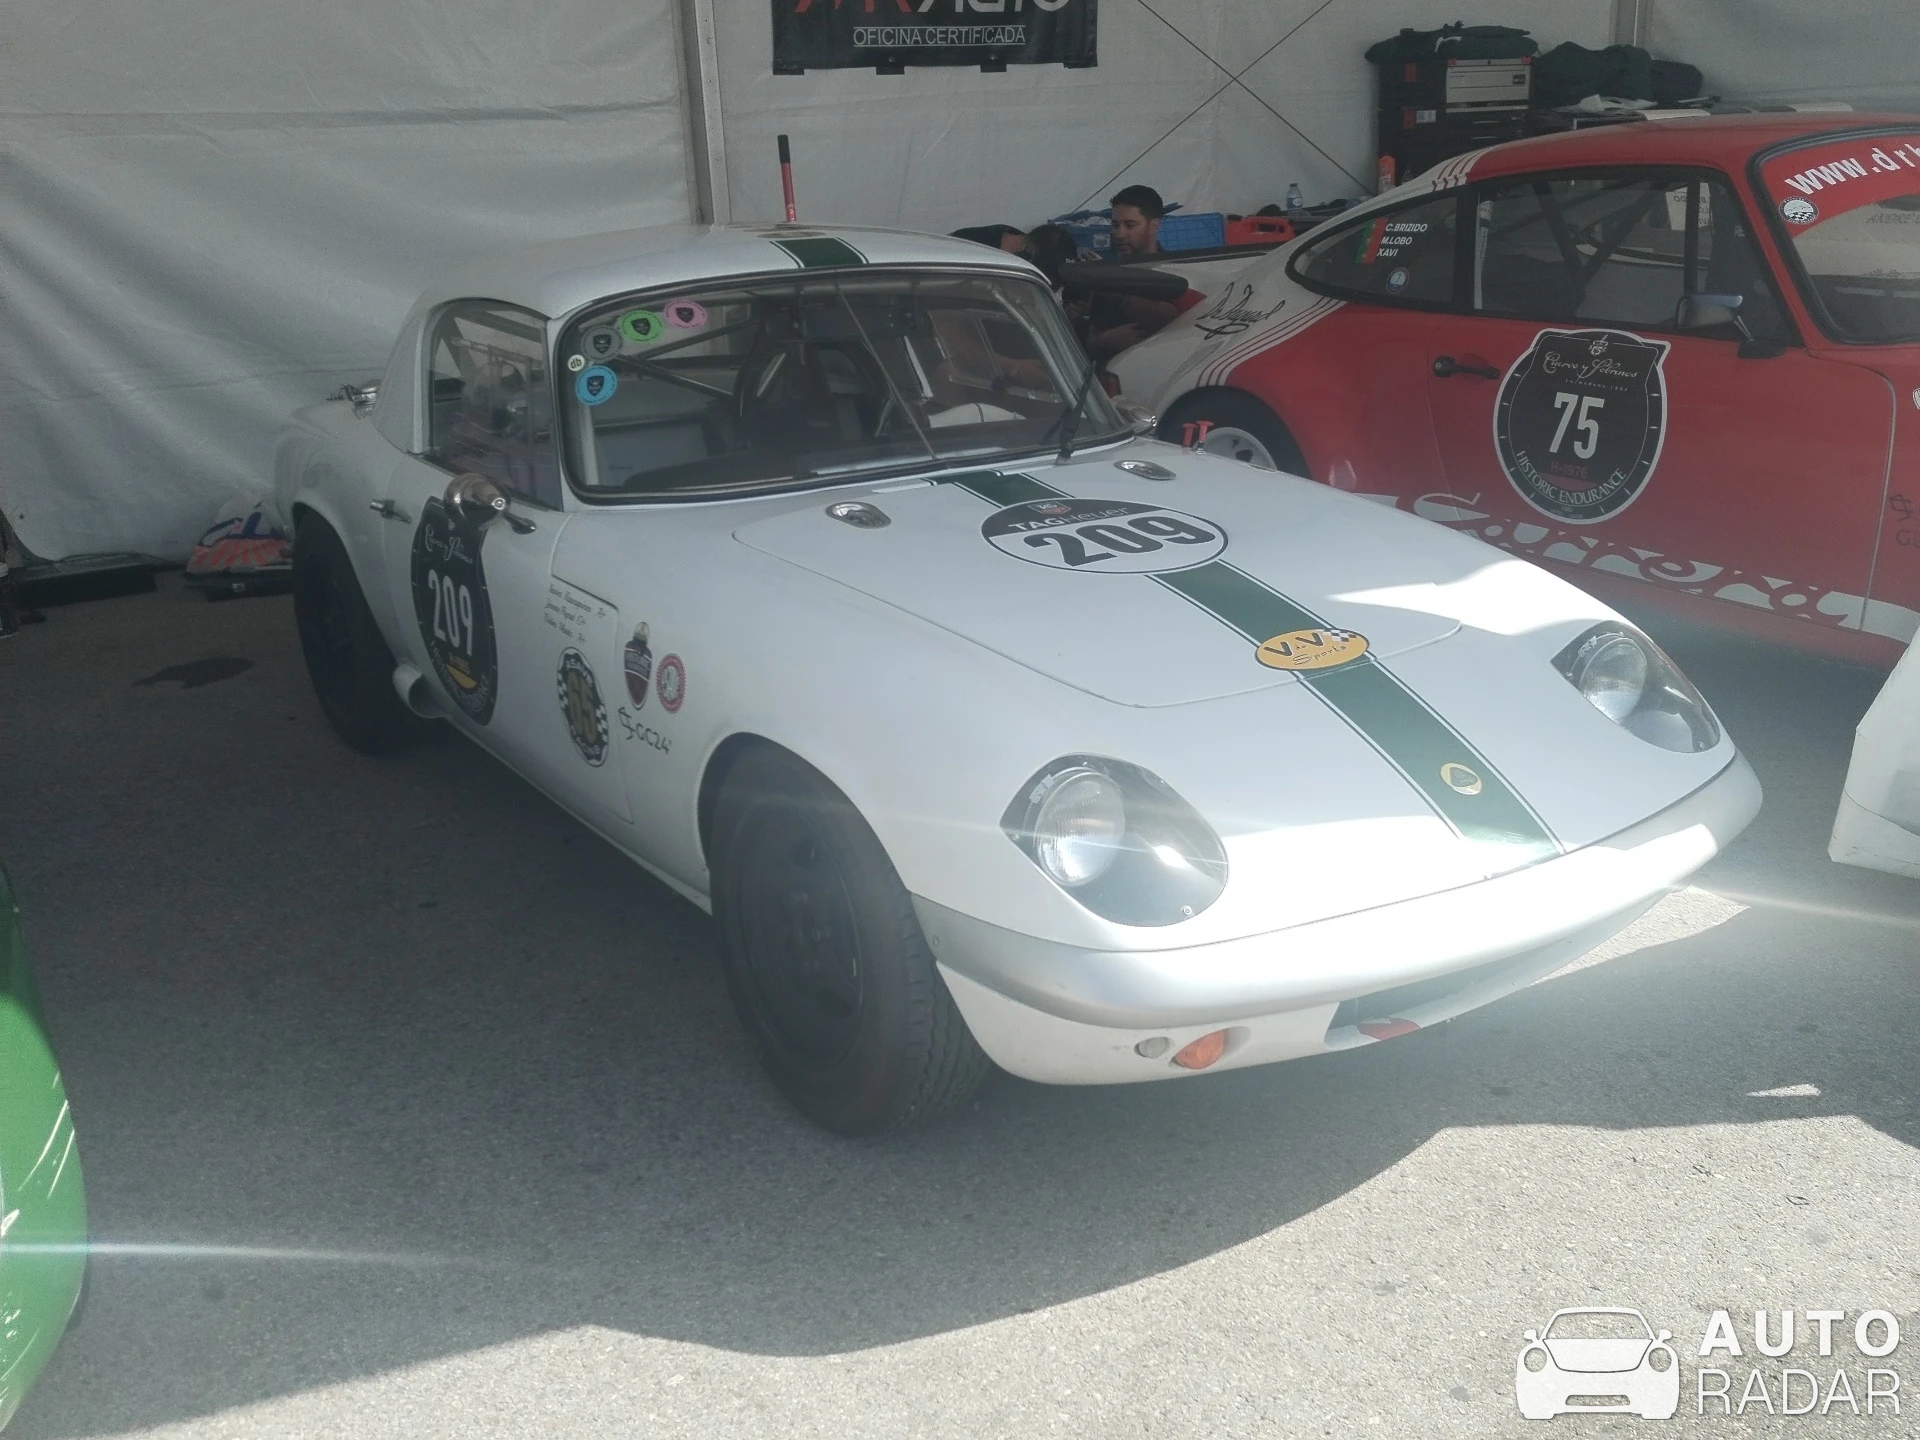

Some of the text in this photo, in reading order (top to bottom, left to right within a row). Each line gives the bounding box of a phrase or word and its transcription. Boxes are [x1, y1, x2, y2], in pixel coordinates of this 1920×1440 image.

[853, 26, 1025, 46] OFICINA CERTIFICADA
[1385, 223, 1428, 232] C.BRIZIDO
[1376, 248, 1399, 257] XAVI
[1380, 236, 1413, 245] M.LOBO
[1548, 392, 1605, 459] 75
[1516, 450, 1627, 505] HISTORIC ENDURANCE
[1023, 516, 1216, 567] 209
[427, 568, 474, 657] 209
[1263, 641, 1293, 657] V
[1294, 632, 1324, 647] V
